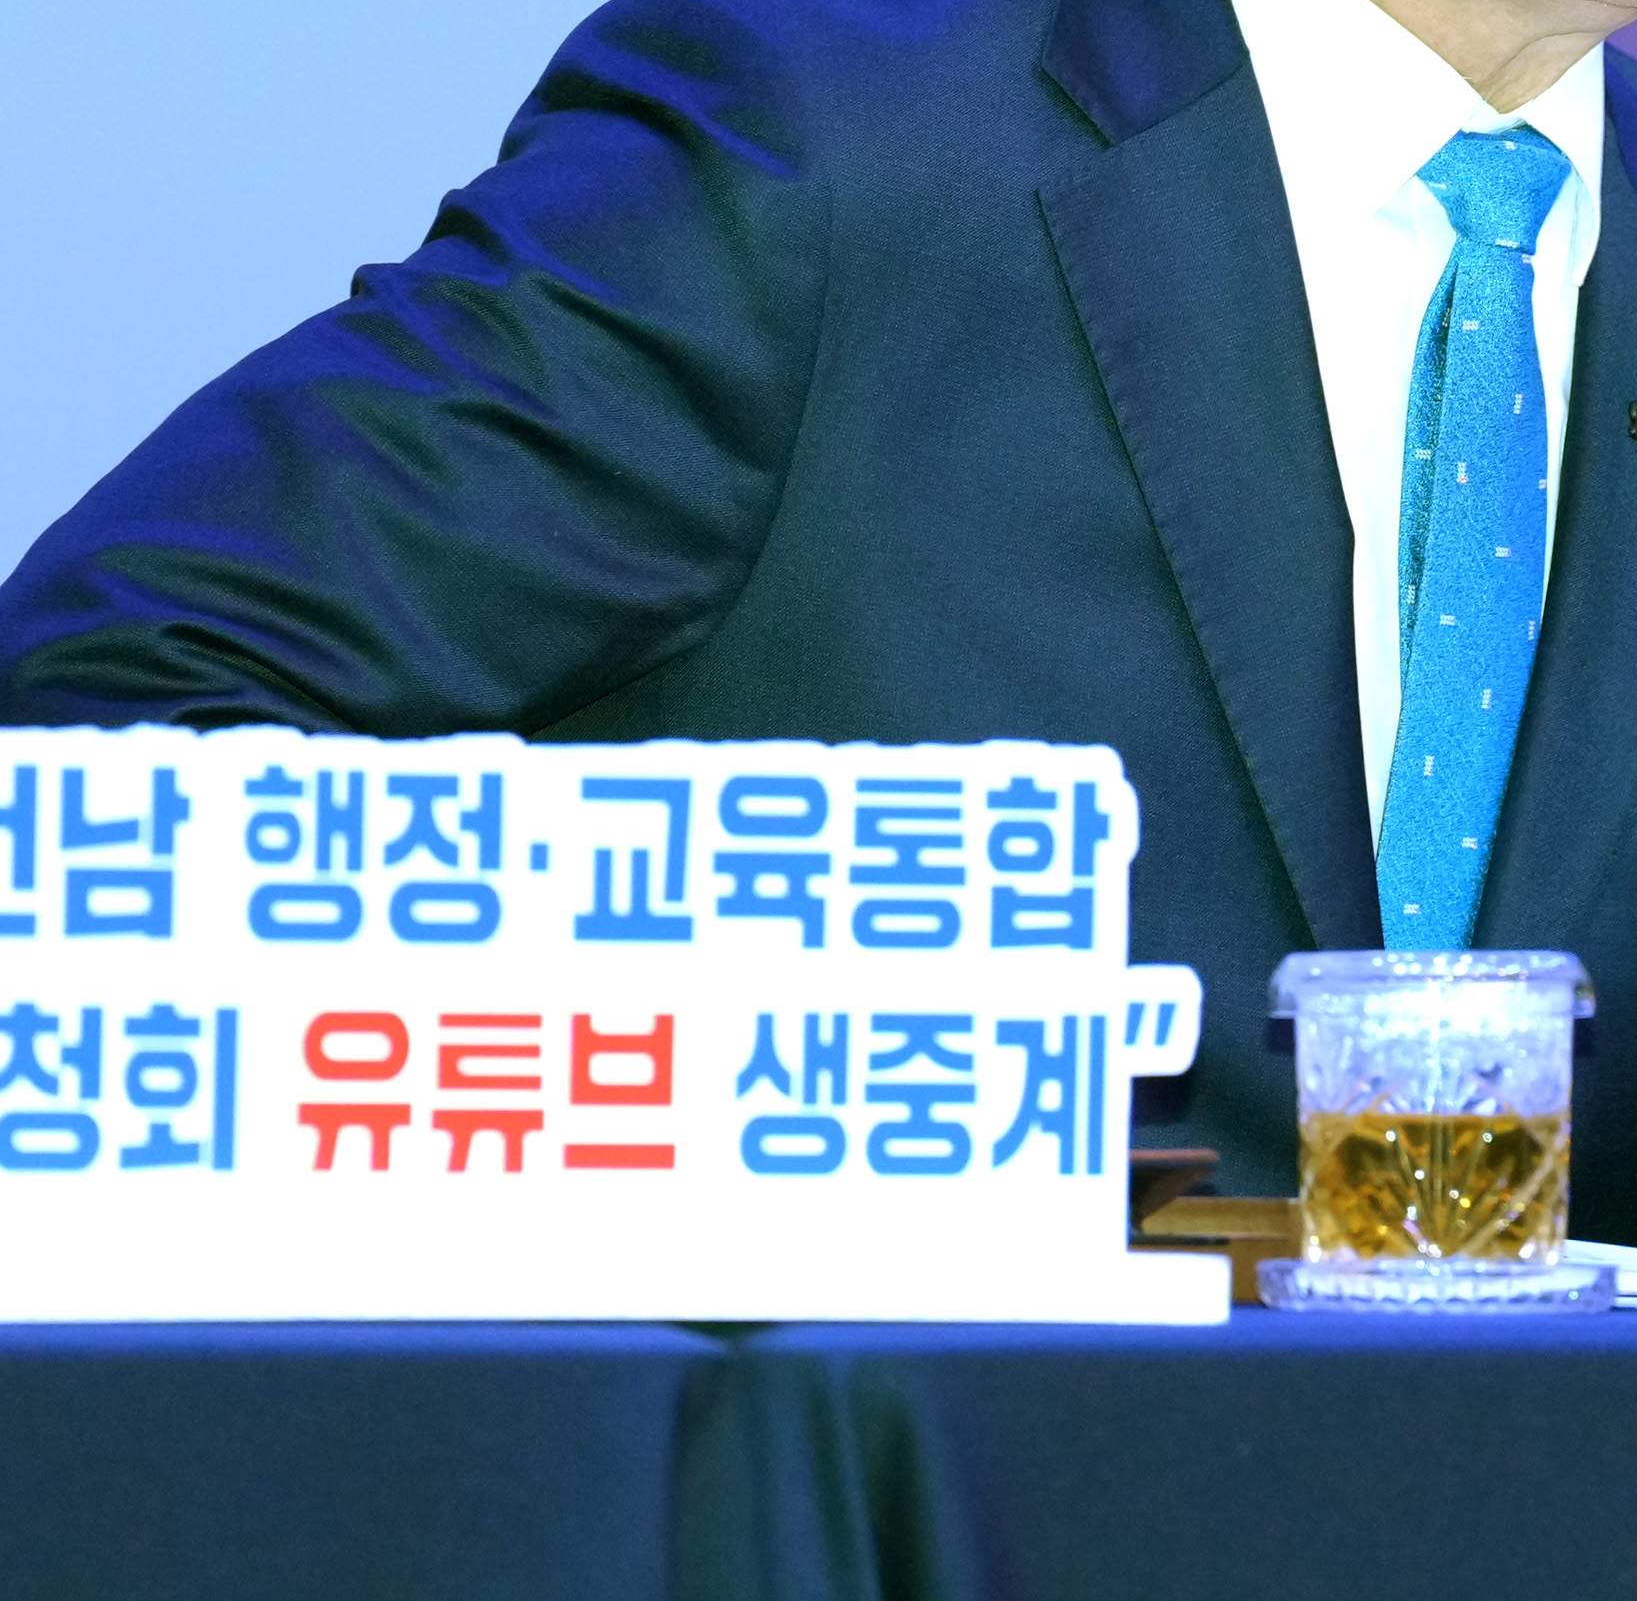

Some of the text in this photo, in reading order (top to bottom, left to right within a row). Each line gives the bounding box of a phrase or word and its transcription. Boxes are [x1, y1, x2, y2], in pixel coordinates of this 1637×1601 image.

[246, 766, 1109, 949] 행정·교육통합
[0, 1004, 237, 1170] 청회
[299, 1012, 675, 1172] 유튜브
